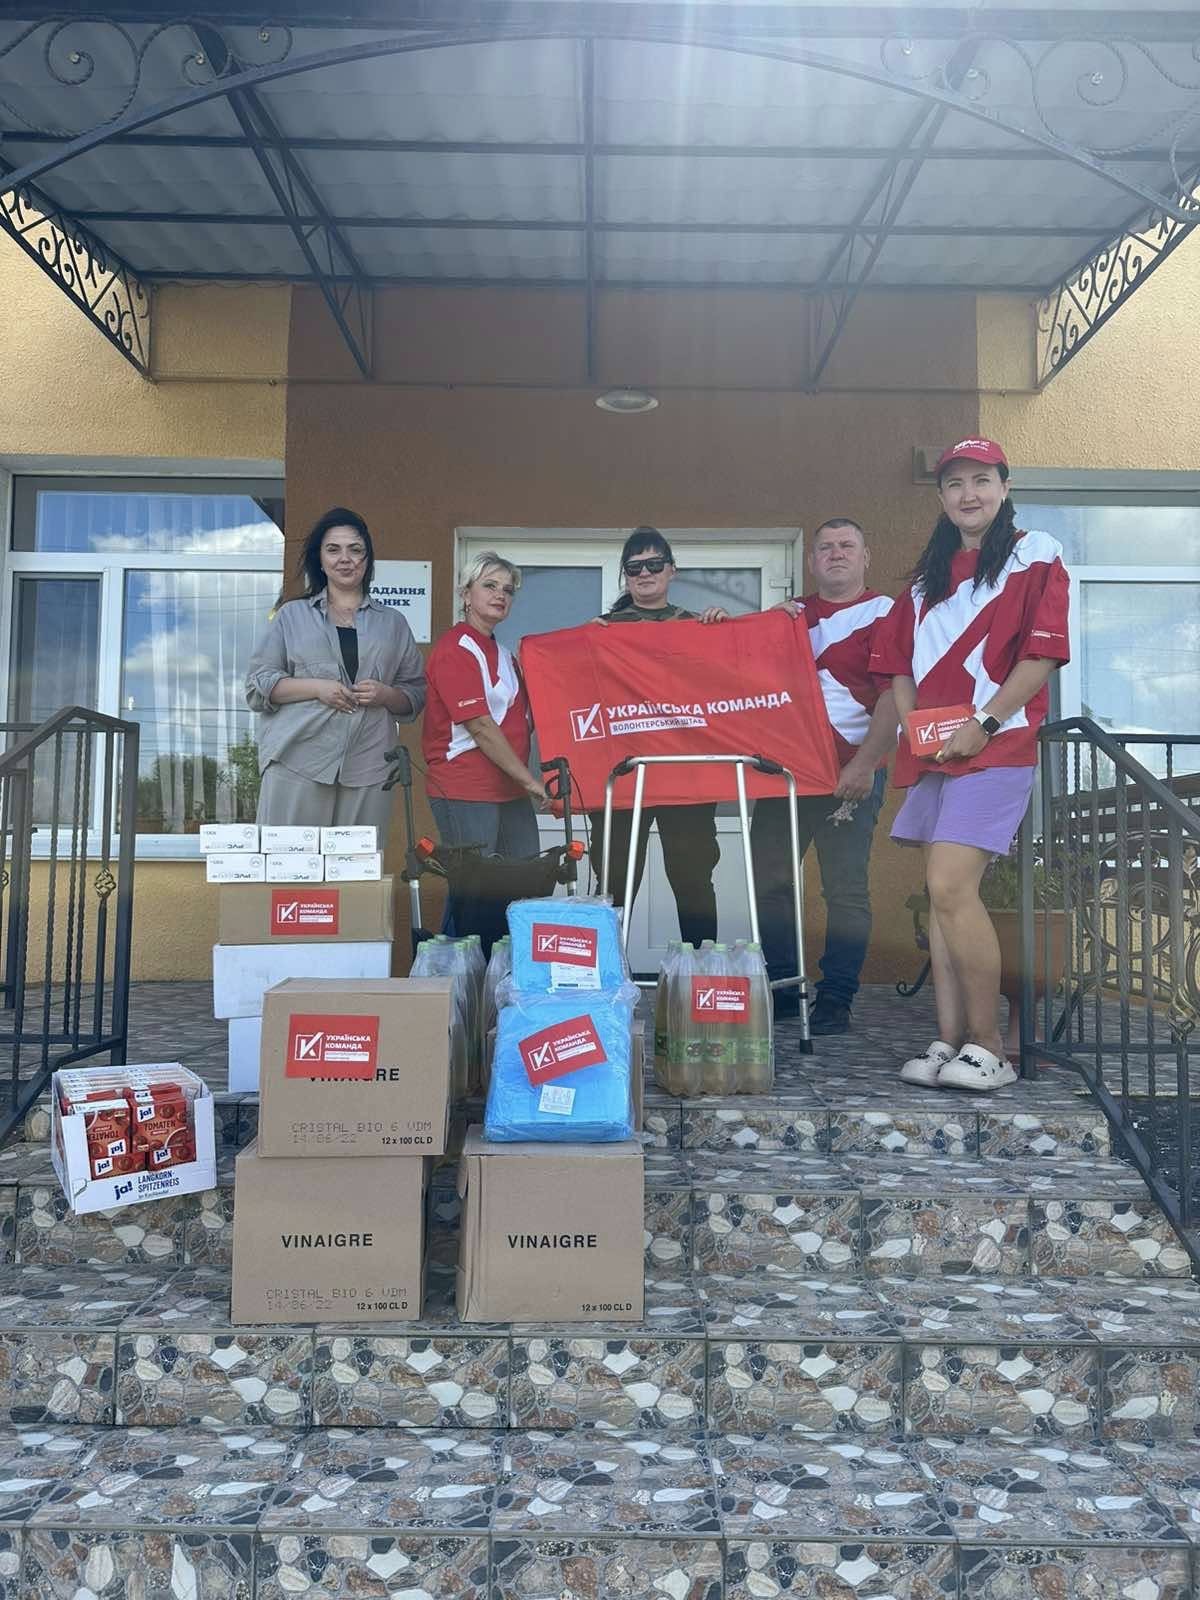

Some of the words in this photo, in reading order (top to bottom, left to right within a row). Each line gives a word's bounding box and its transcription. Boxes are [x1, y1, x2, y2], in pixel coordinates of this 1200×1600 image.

[369, 587, 425, 595] АДАННЯ
[606, 700, 704, 719] УКРАЇНСЬКА
[706, 691, 793, 715] КОМАНДА
[325, 1033, 371, 1042] УКРАЇНСЬКА
[139, 1107, 152, 1120] ja!
[144, 1120, 176, 1131] TOMATEN
[291, 1122, 349, 1133] CRISTAL
[357, 1122, 383, 1132] BIO
[382, 1137, 391, 1145] 12
[399, 1137, 413, 1145] 100
[414, 1136, 425, 1144] CL
[426, 1136, 433, 1144] D
[156, 1149, 169, 1161] ja!
[97, 1160, 110, 1173] ja!
[114, 1181, 133, 1200] ja!
[138, 1178, 180, 1193] SPITZENREIS
[281, 1233, 373, 1248] VINAIGRE
[508, 1234, 597, 1248] VINAIGRE
[265, 1288, 323, 1299] CRISTAL
[332, 1288, 357, 1298] BIO
[365, 1288, 374, 1298] 6
[357, 1302, 366, 1310] 12
[374, 1302, 388, 1310] 100
[389, 1302, 401, 1310] CL
[401, 1301, 408, 1309] D
[599, 1303, 612, 1311] 100
[613, 1303, 624, 1311] CL
[625, 1303, 632, 1311] D
